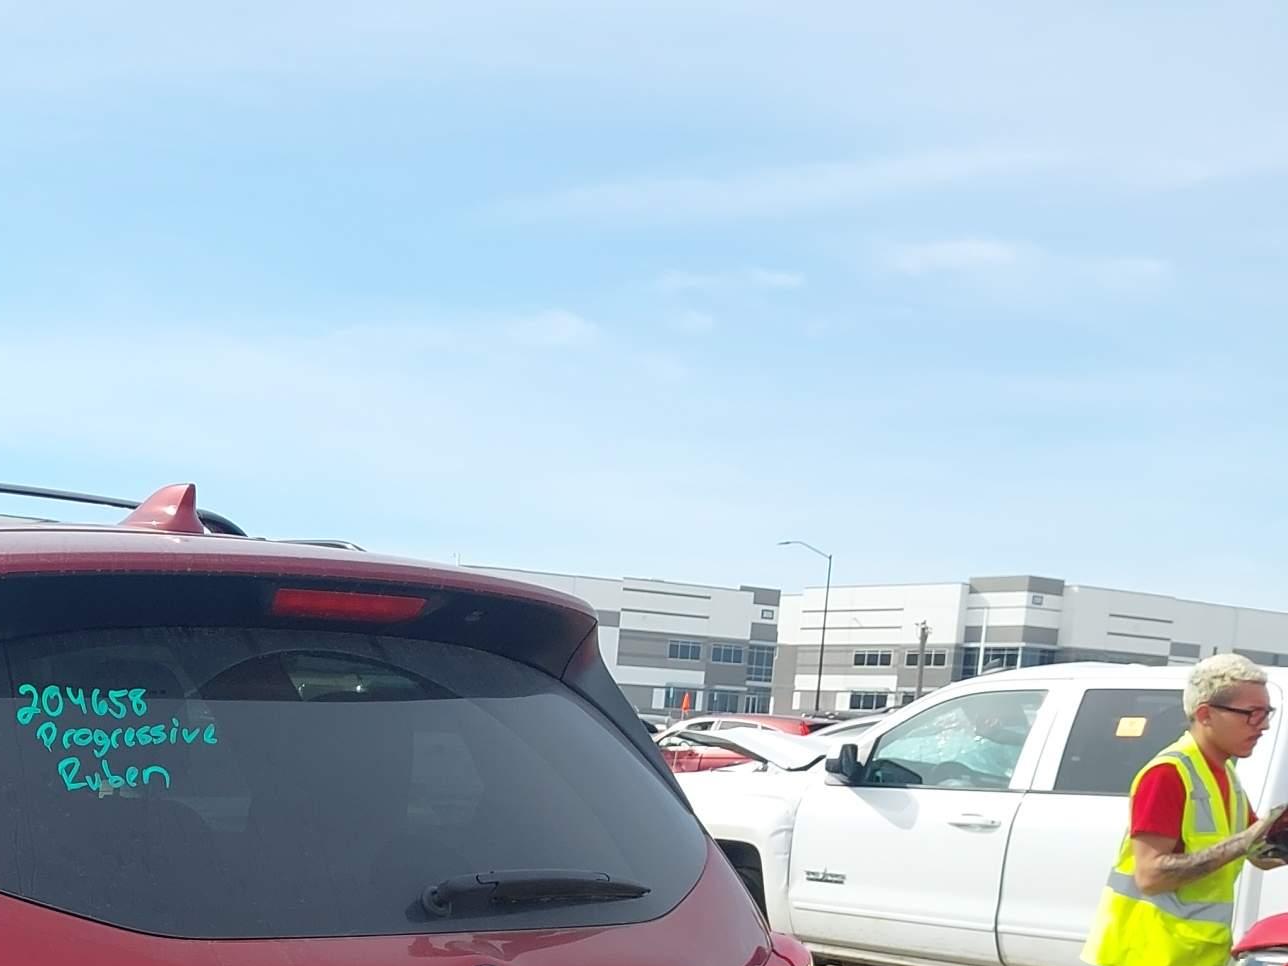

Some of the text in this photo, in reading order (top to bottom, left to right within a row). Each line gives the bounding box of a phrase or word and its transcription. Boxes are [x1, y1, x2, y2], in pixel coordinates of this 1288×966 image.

[16, 683, 147, 725] 204658
[36, 718, 218, 758] Progressive
[58, 756, 170, 791] Ruben
